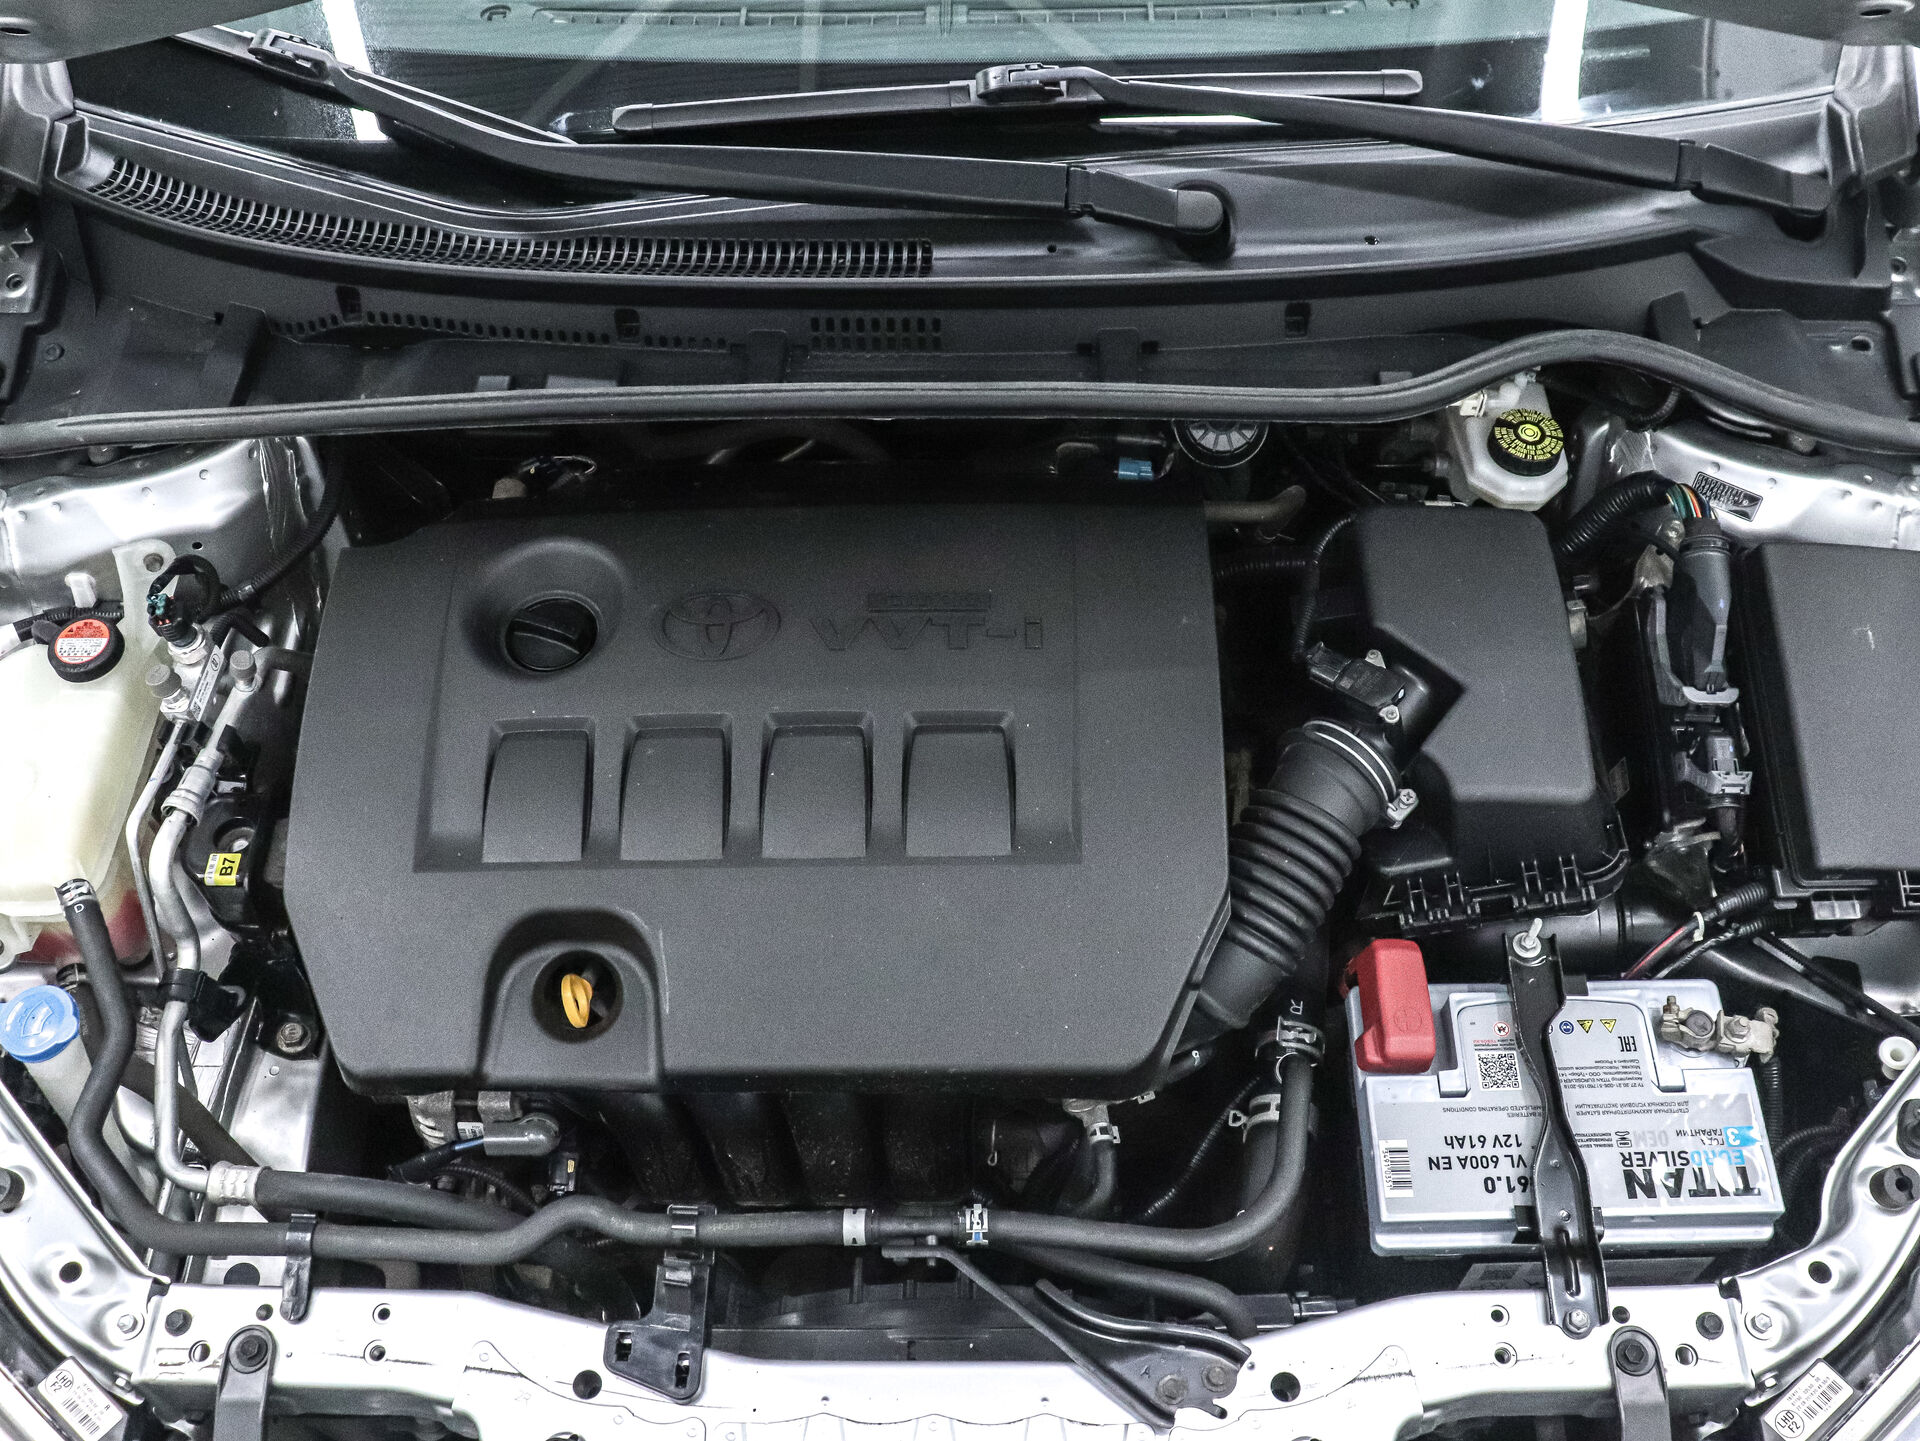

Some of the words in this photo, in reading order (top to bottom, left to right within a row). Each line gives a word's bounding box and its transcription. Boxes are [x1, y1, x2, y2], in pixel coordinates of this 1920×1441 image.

[219, 857, 235, 876] B7
[1290, 999, 1303, 1015] R
[1444, 1135, 1487, 1149] 61Ah
[1493, 1134, 1522, 1148] 12V
[1726, 1128, 1740, 1145] 3
[1428, 1156, 1452, 1171] EN
[1456, 1155, 1499, 1169] 600A
[1504, 1154, 1527, 1169] VL
[1623, 1166, 1762, 1199] TTAN
[50, 1381, 62, 1392] F2
[56, 1372, 73, 1388] LHD
[1777, 1410, 1794, 1428] LHD
[1788, 1421, 1800, 1433] F2
